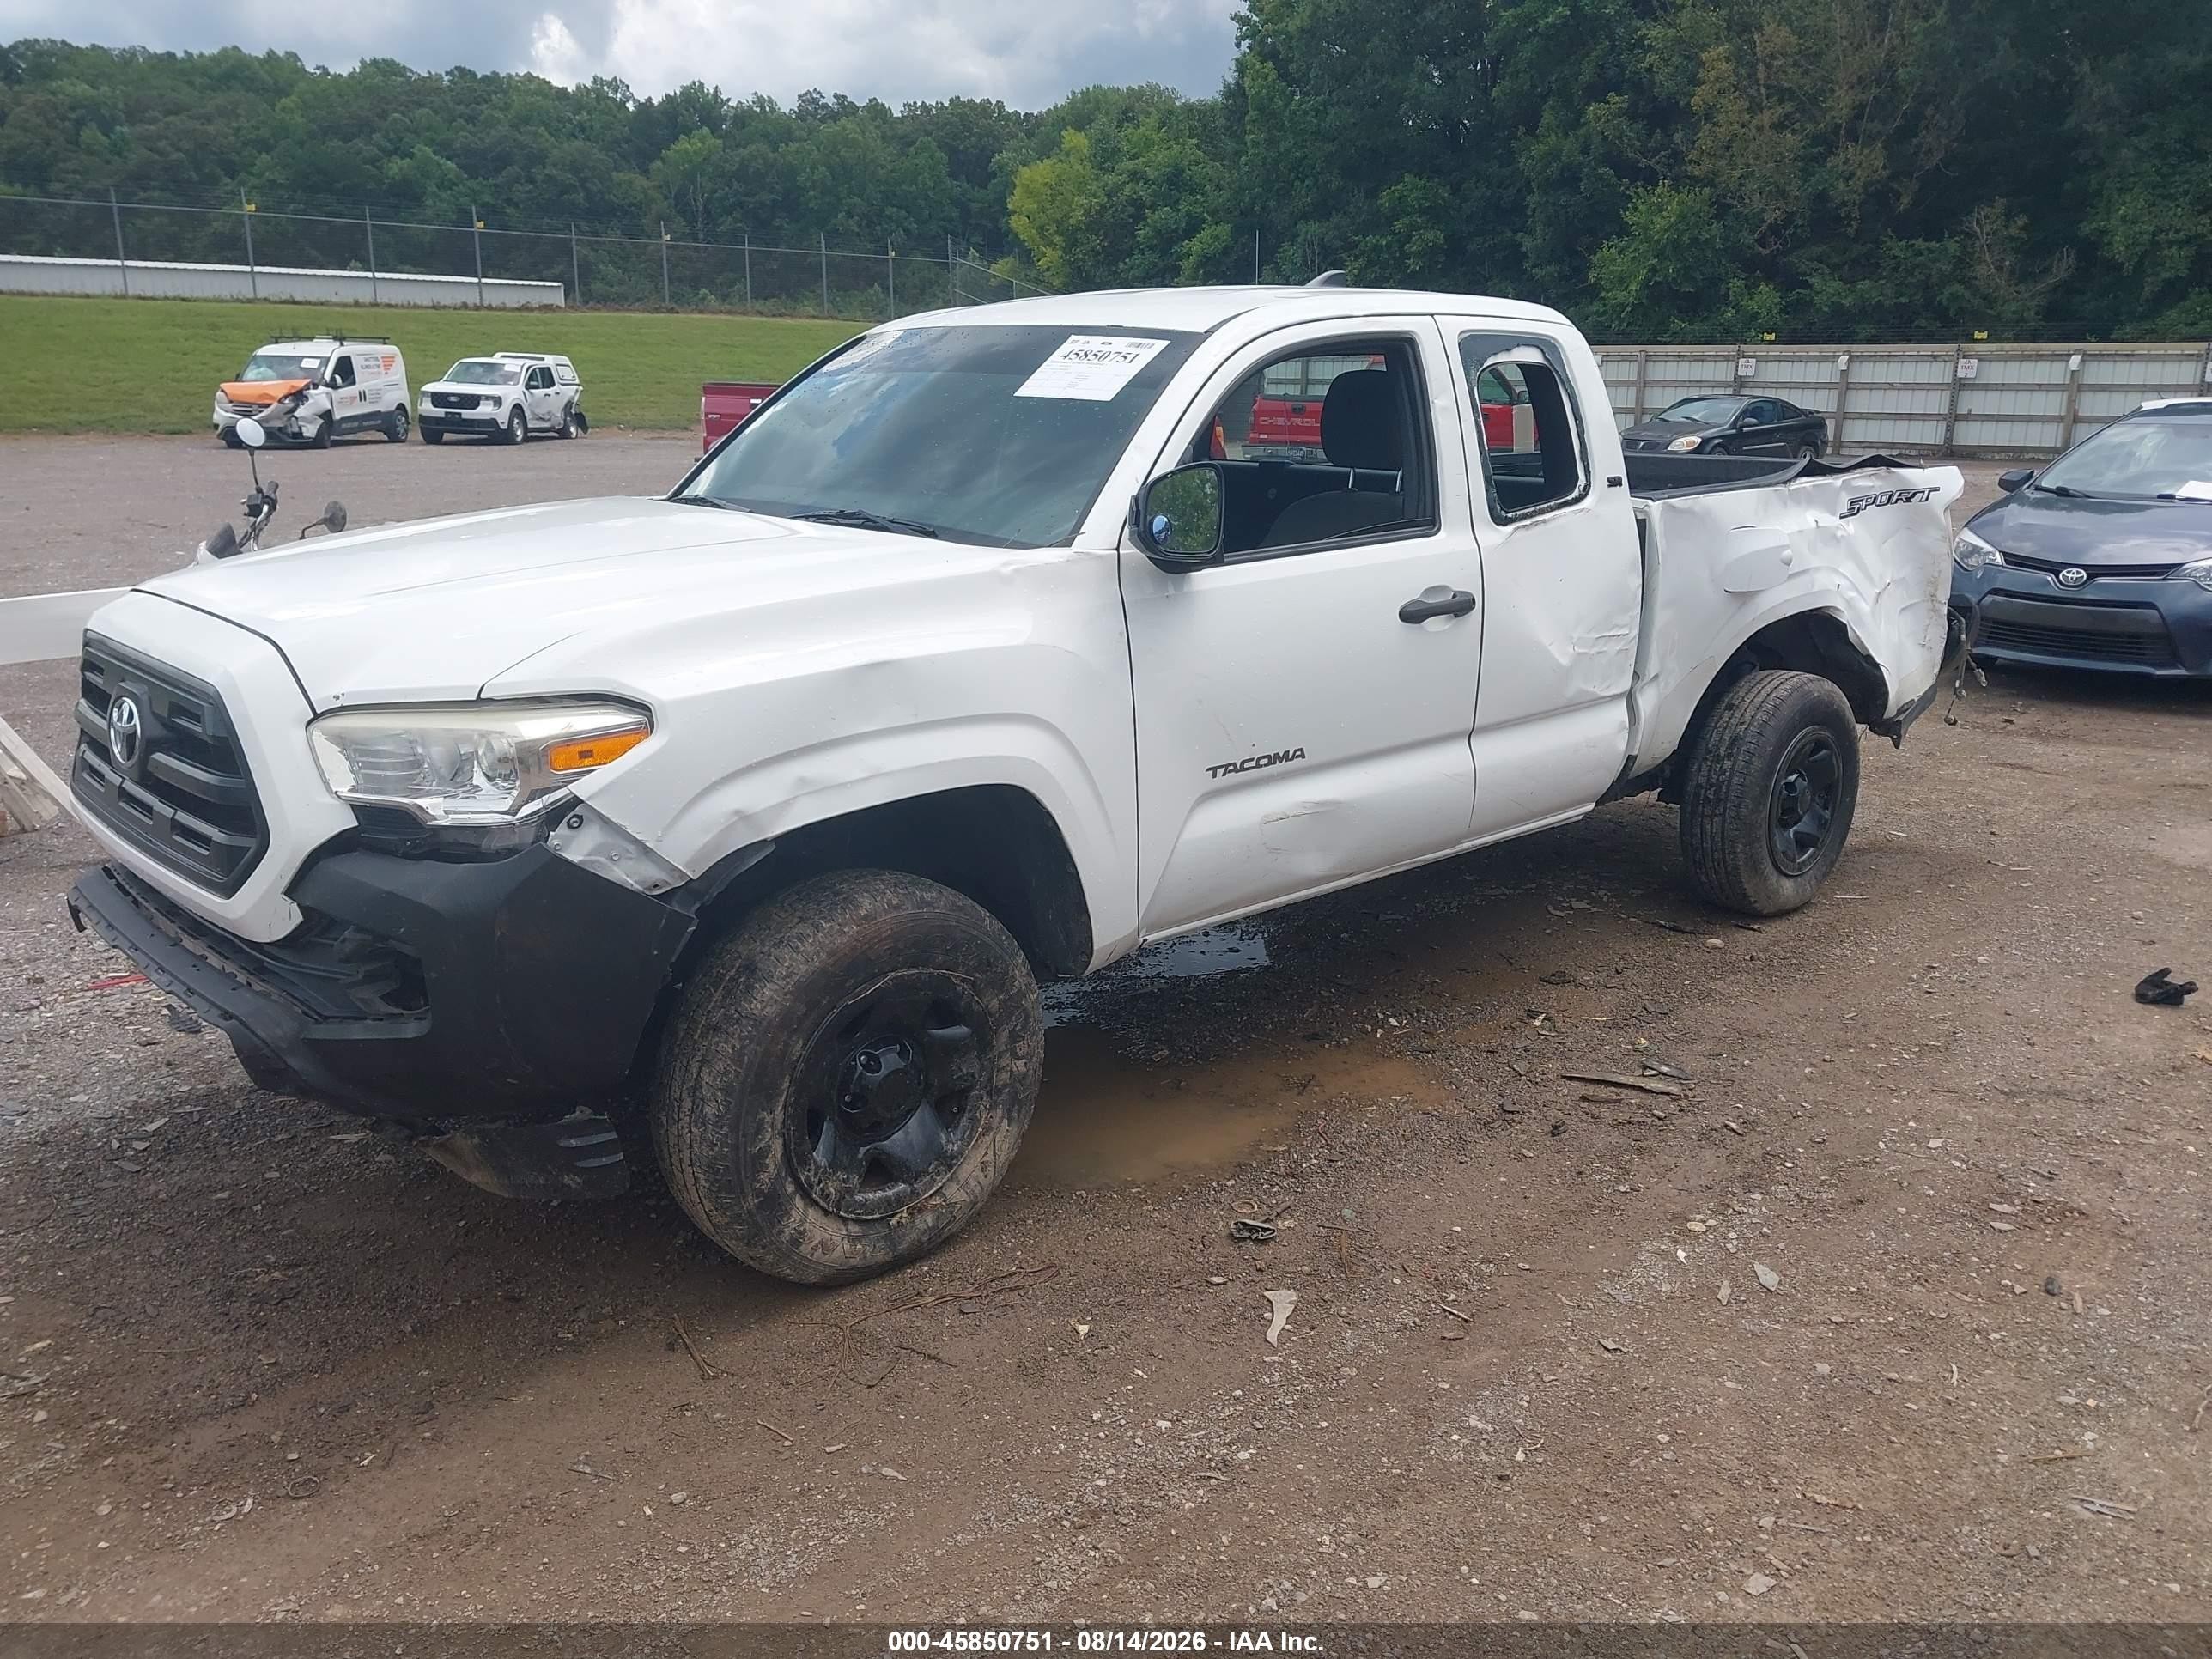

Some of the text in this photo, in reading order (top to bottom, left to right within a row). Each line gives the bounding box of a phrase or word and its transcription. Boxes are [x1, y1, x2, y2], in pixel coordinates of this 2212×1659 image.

[1060, 349, 1140, 364] 45850751
[1259, 416, 1320, 427] CHEVROL
[1838, 486, 1941, 520] SPORT
[1205, 747, 1306, 780] TACOMA
